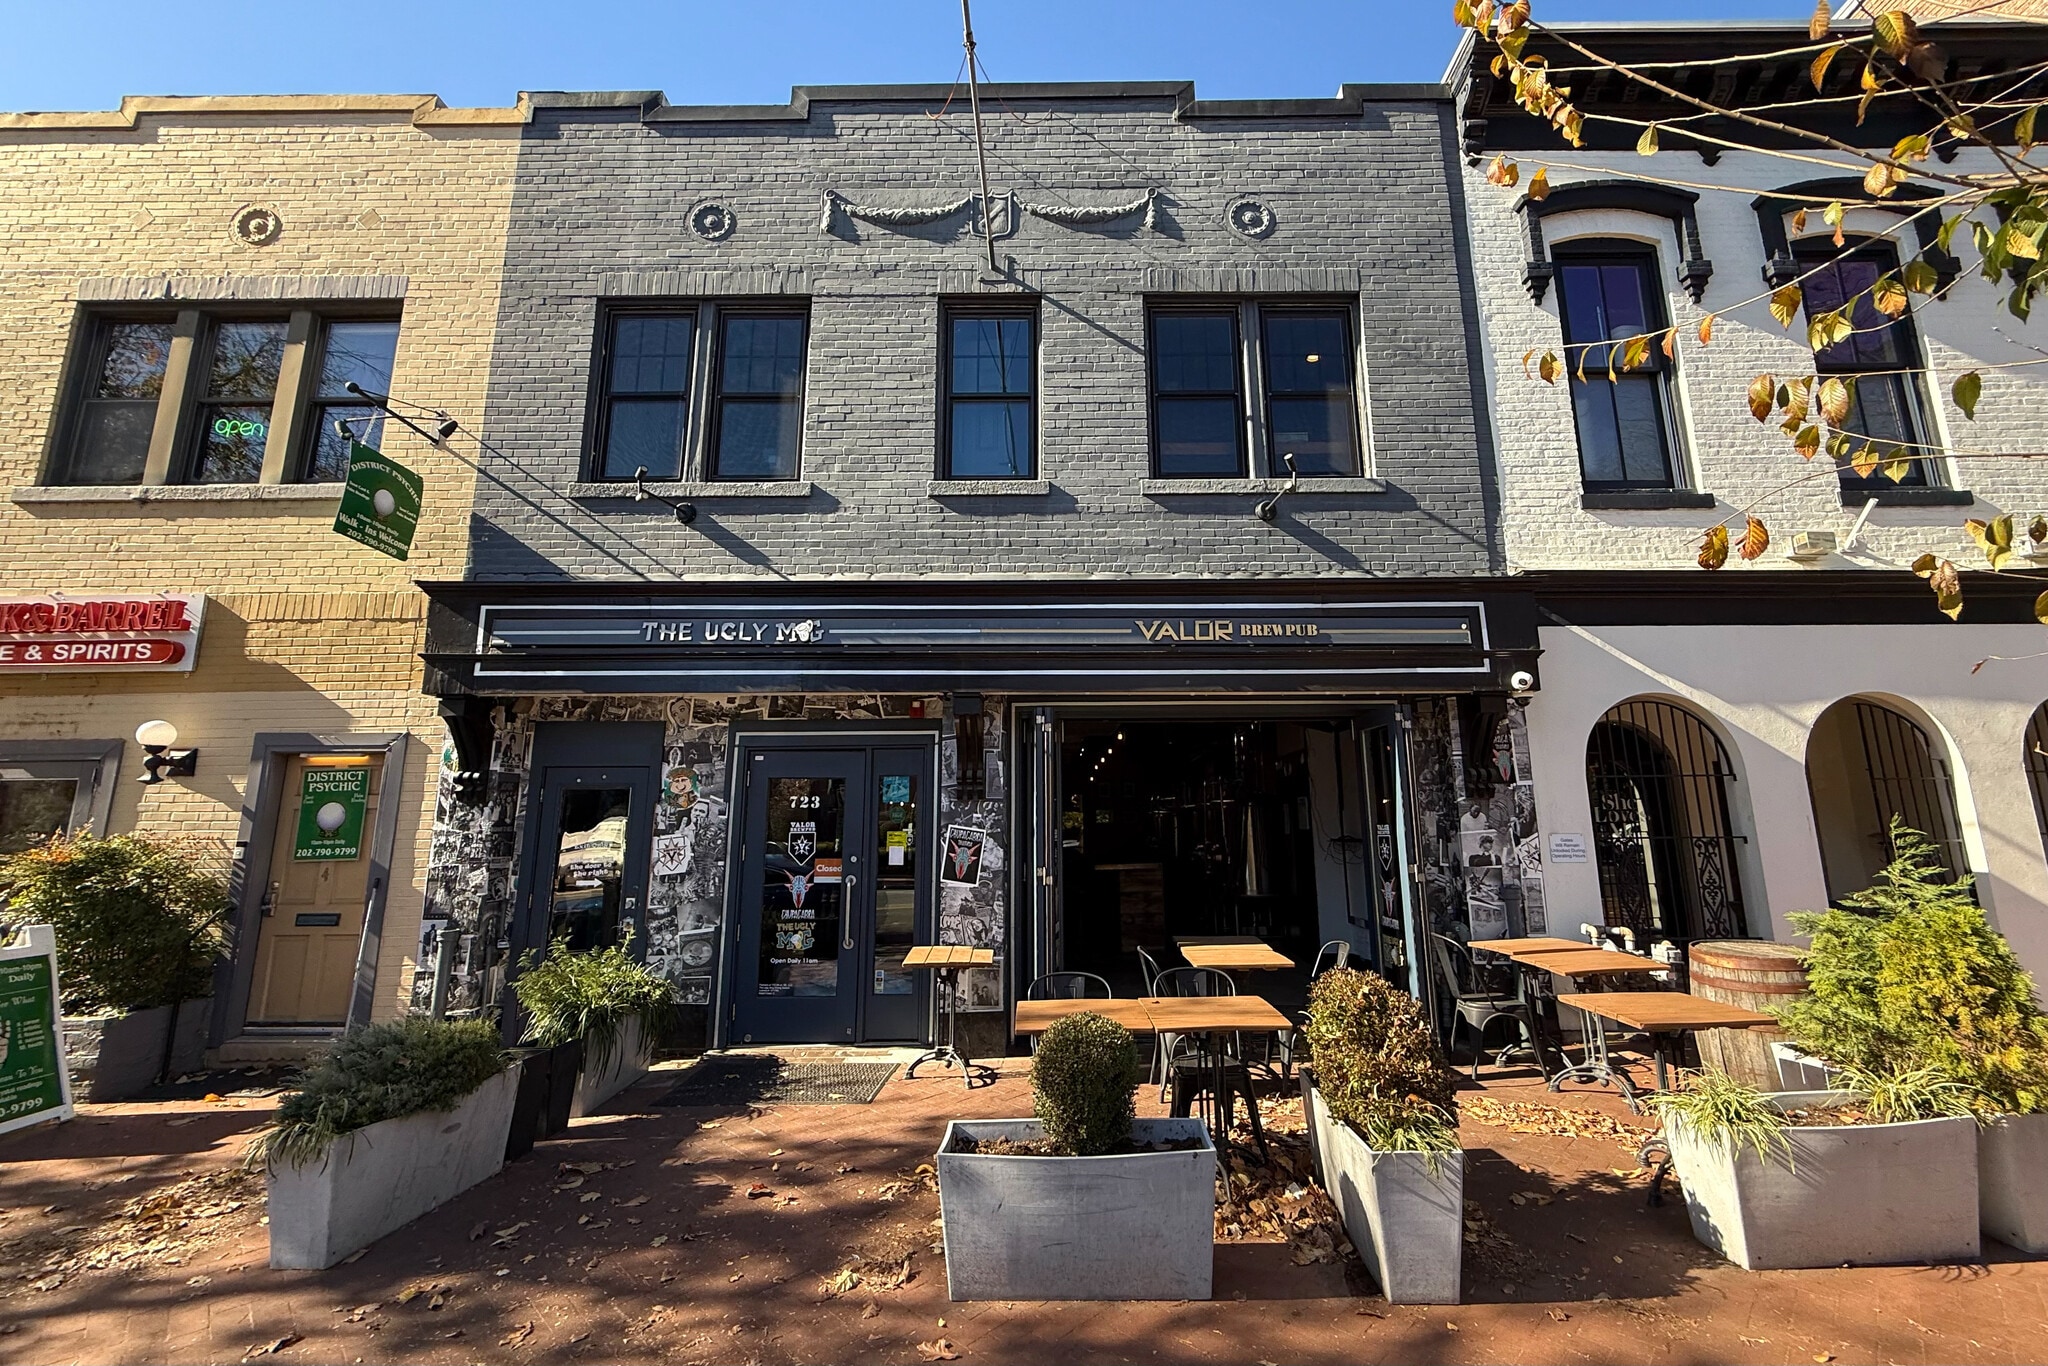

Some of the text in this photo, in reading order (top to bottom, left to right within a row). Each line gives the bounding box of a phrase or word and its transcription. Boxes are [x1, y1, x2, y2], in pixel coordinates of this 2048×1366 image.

[351, 461, 421, 506] DISTRICT PSYCHIC
[339, 512, 359, 528] Walk
[365, 525, 377, 537] Ins
[378, 531, 409, 551] Welcome
[347, 528, 398, 555] 202-790-9799
[642, 620, 824, 642] THE UGLY MG
[1135, 620, 1318, 641] VALOR BREW PUB
[24, 645, 42, 660] &
[52, 643, 152, 660] SPIRITS
[307, 771, 364, 782] DISTRICT
[309, 782, 361, 792] PSYCHIC
[790, 795, 820, 809] 723
[296, 847, 357, 857] 202-790-9799
[816, 864, 842, 872] Closed
[776, 922, 816, 931] THE UGLY
[776, 930, 815, 950] MG
[9, 973, 36, 983] Daily
